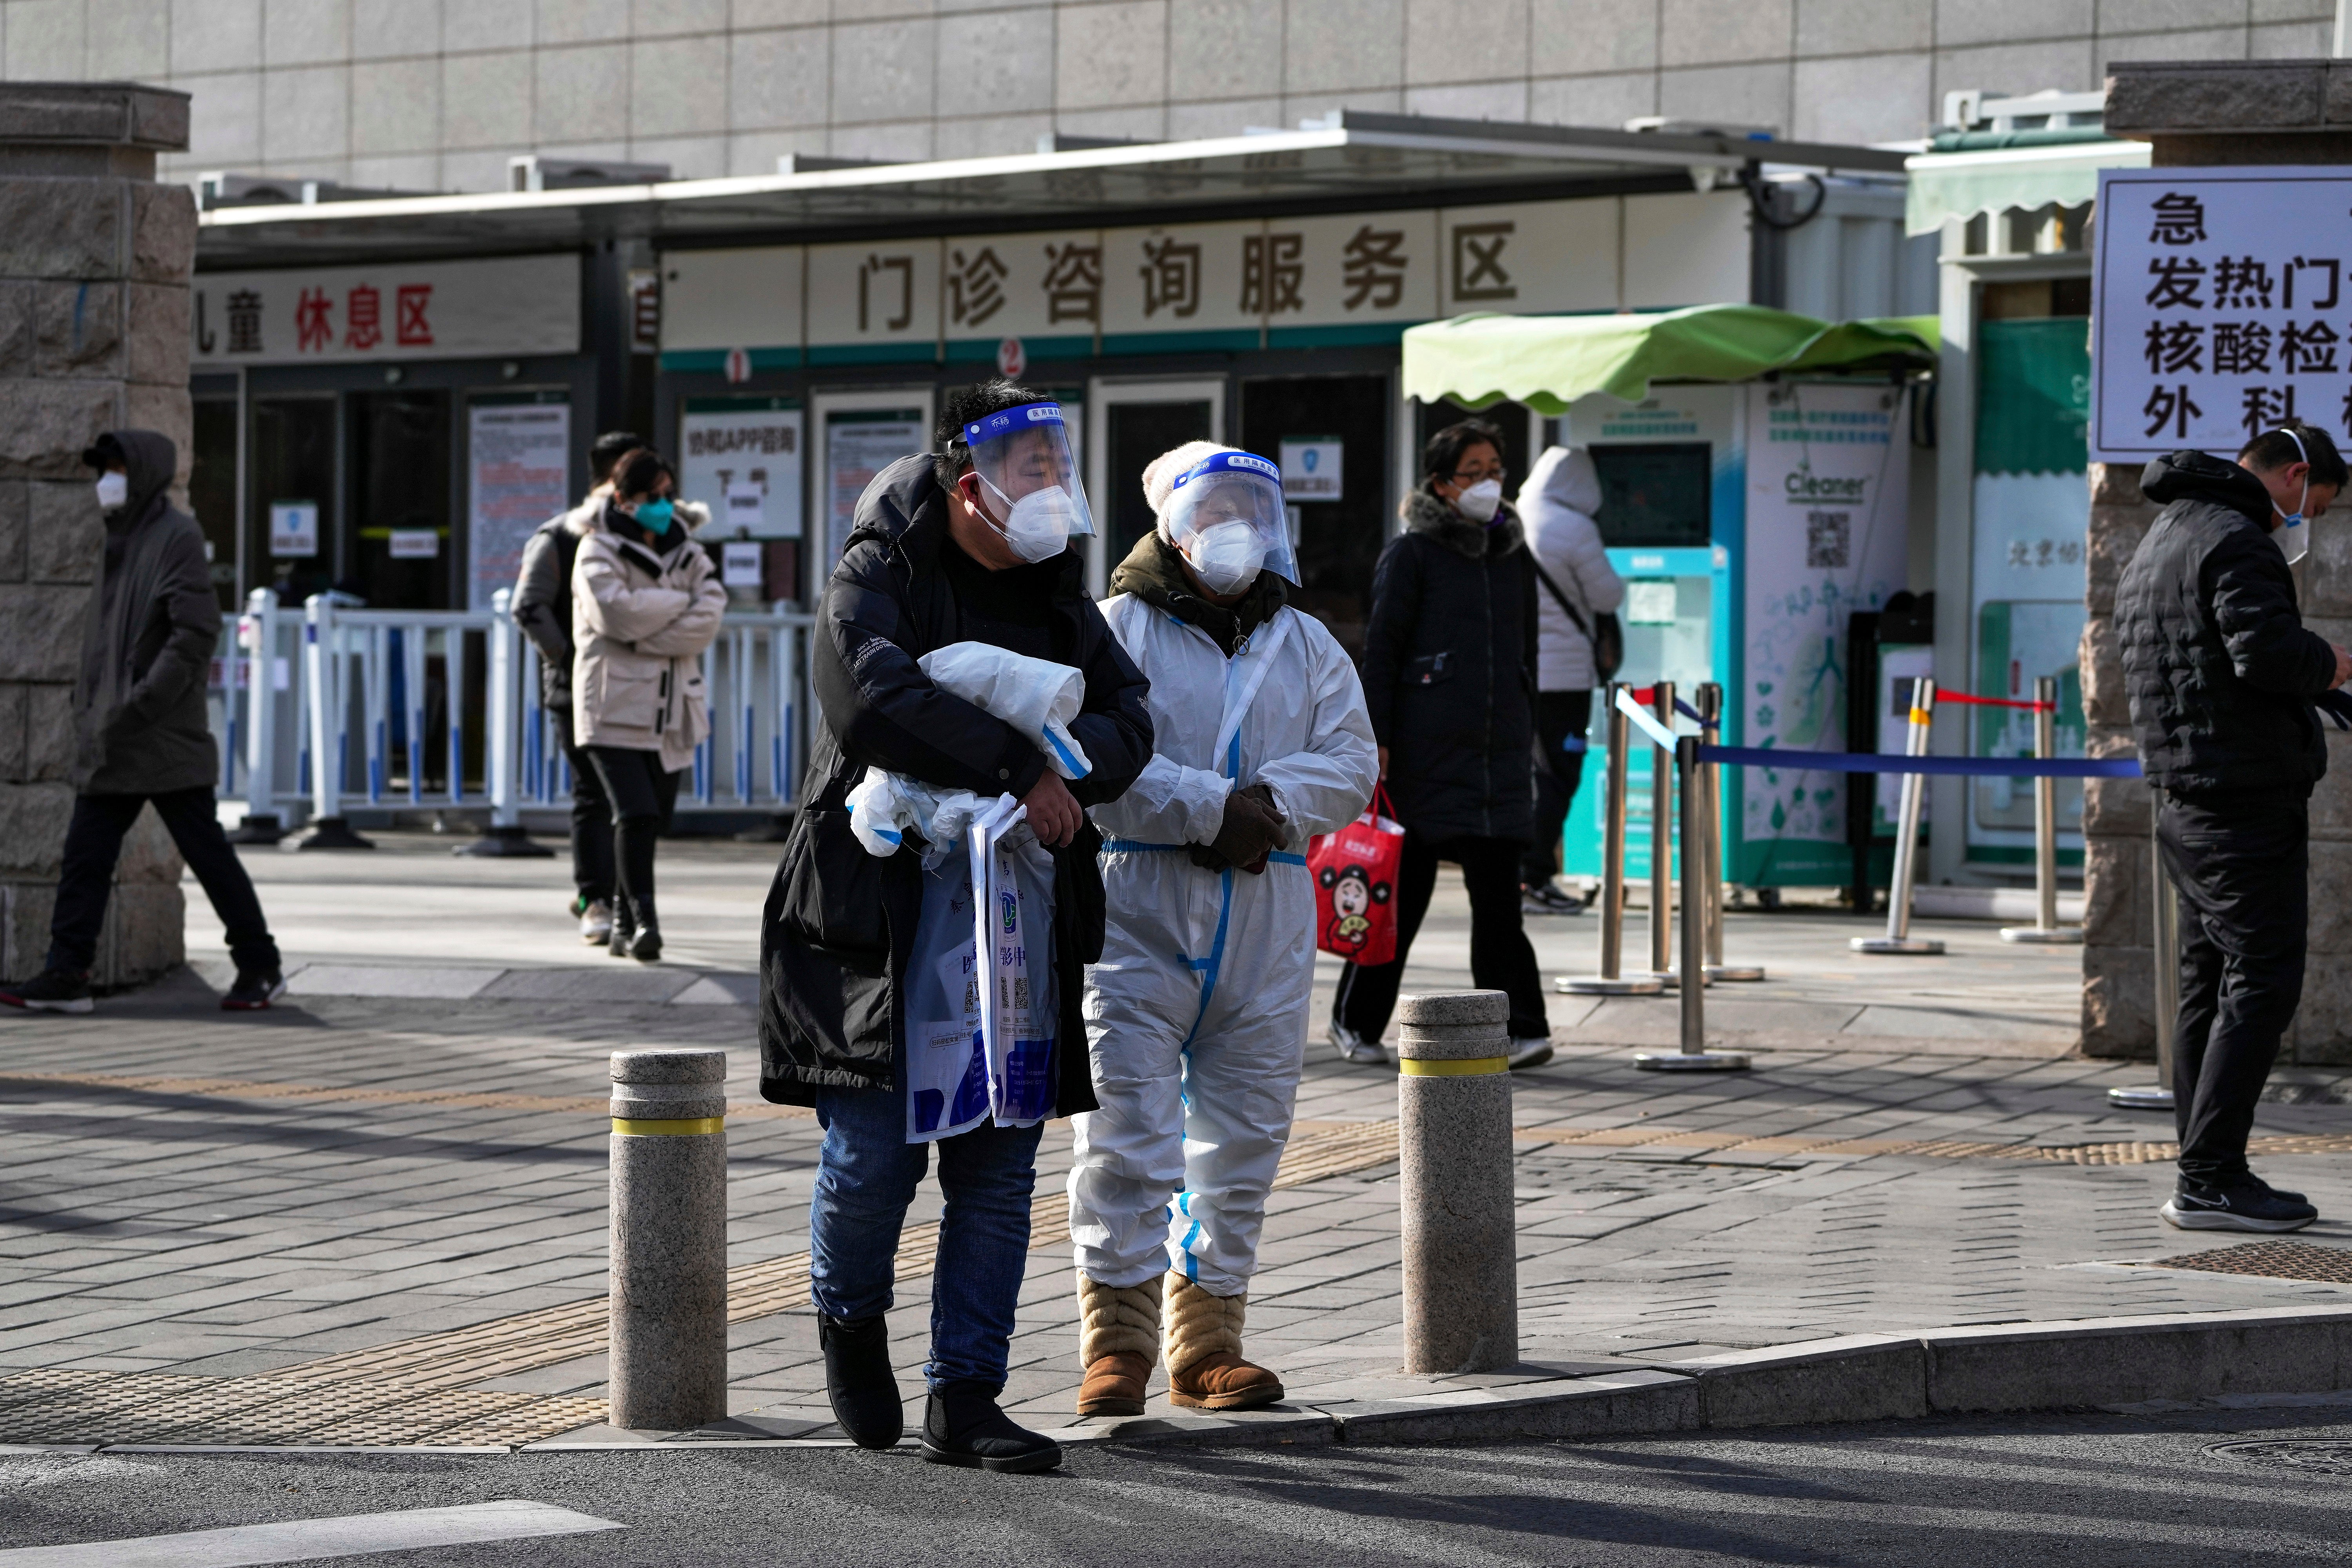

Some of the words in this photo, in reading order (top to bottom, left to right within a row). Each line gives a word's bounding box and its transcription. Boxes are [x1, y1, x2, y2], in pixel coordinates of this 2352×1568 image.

[2149, 191, 2207, 245] 急
[857, 221, 1517, 332] 门诊咨询服务区
[2145, 255, 2352, 311] 发热门
[296, 282, 434, 352] 休息区
[731, 350, 744, 383] 1
[1004, 339, 1020, 375] 2
[2145, 318, 2352, 375] 核酸检
[2143, 384, 2352, 439] 外科
[1785, 472, 1866, 495] Cleaner
[857, 641, 869, 652] DON'T
[860, 648, 876, 661] TRASH
[931, 1036, 959, 1046] 扫码轻松实现
